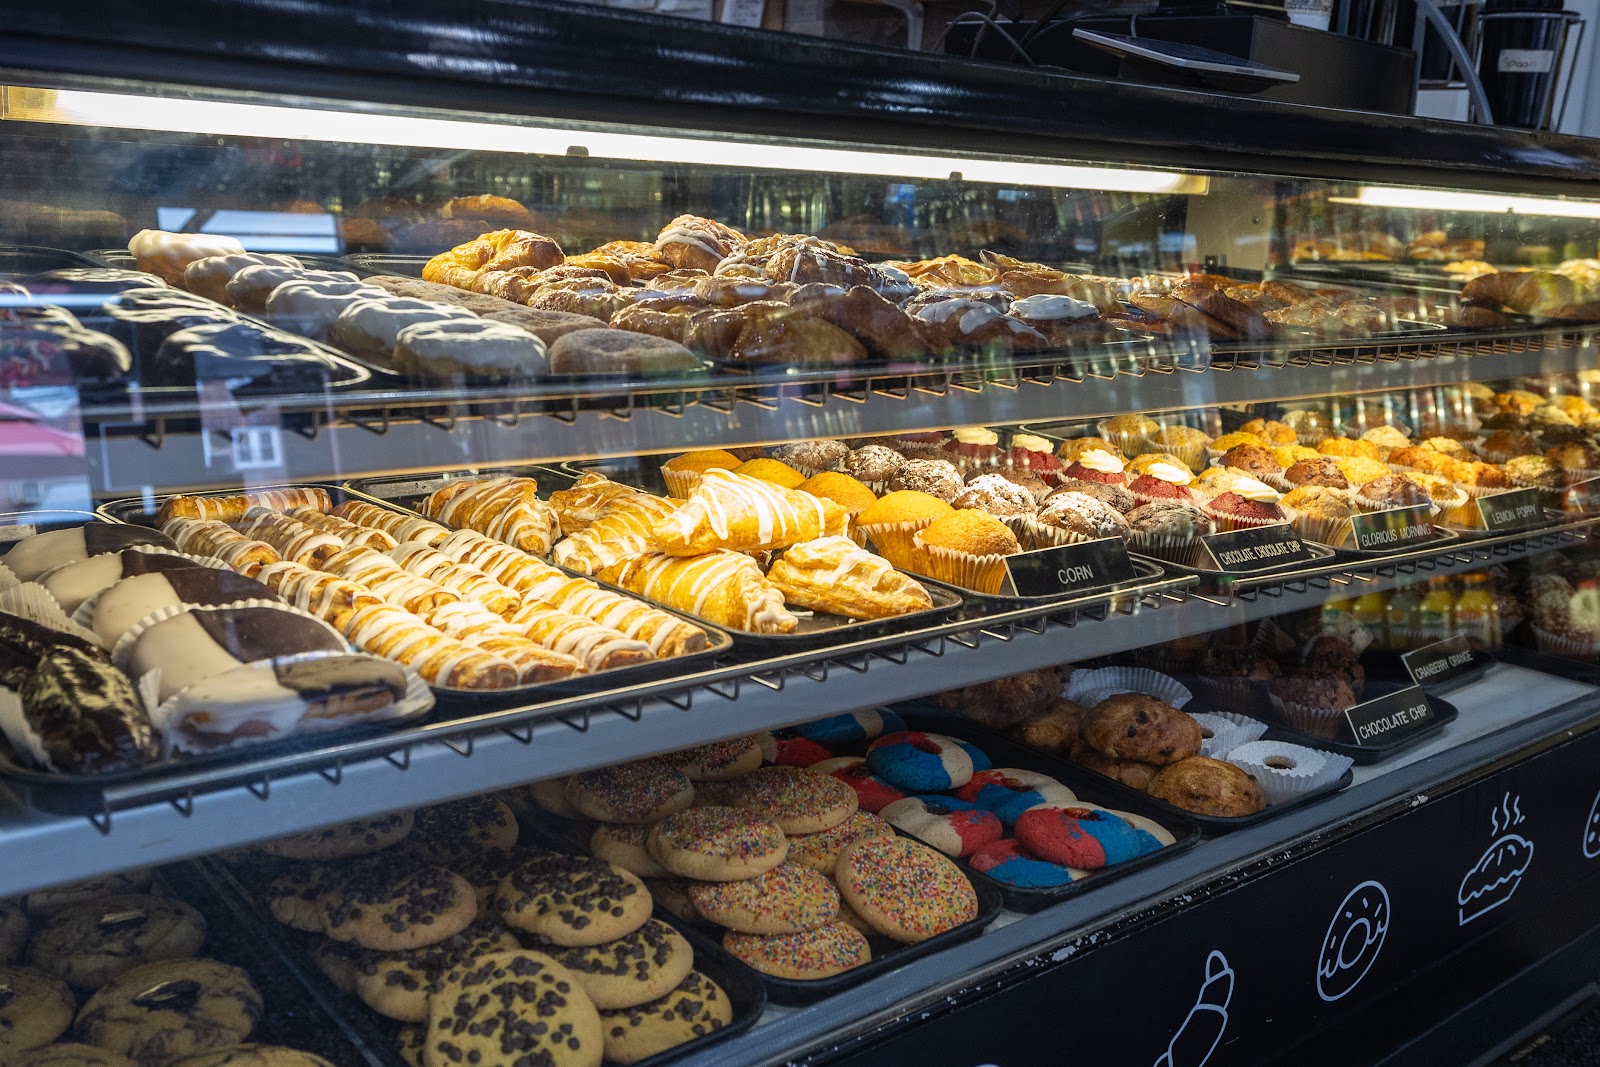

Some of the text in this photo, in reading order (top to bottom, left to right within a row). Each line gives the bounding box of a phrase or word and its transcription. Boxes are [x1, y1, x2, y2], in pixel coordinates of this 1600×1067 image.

[1492, 505, 1537, 525] LEMON POPPY
[1361, 523, 1432, 547] GLORIOUS MORNING
[1253, 542, 1289, 559] CHOCOLATE
[1286, 540, 1302, 553] CHIP
[1057, 564, 1094, 585] CORN
[1414, 650, 1474, 680] CRANBERRY ORANGE
[1359, 704, 1427, 739] CHOCOLATE CHIP
